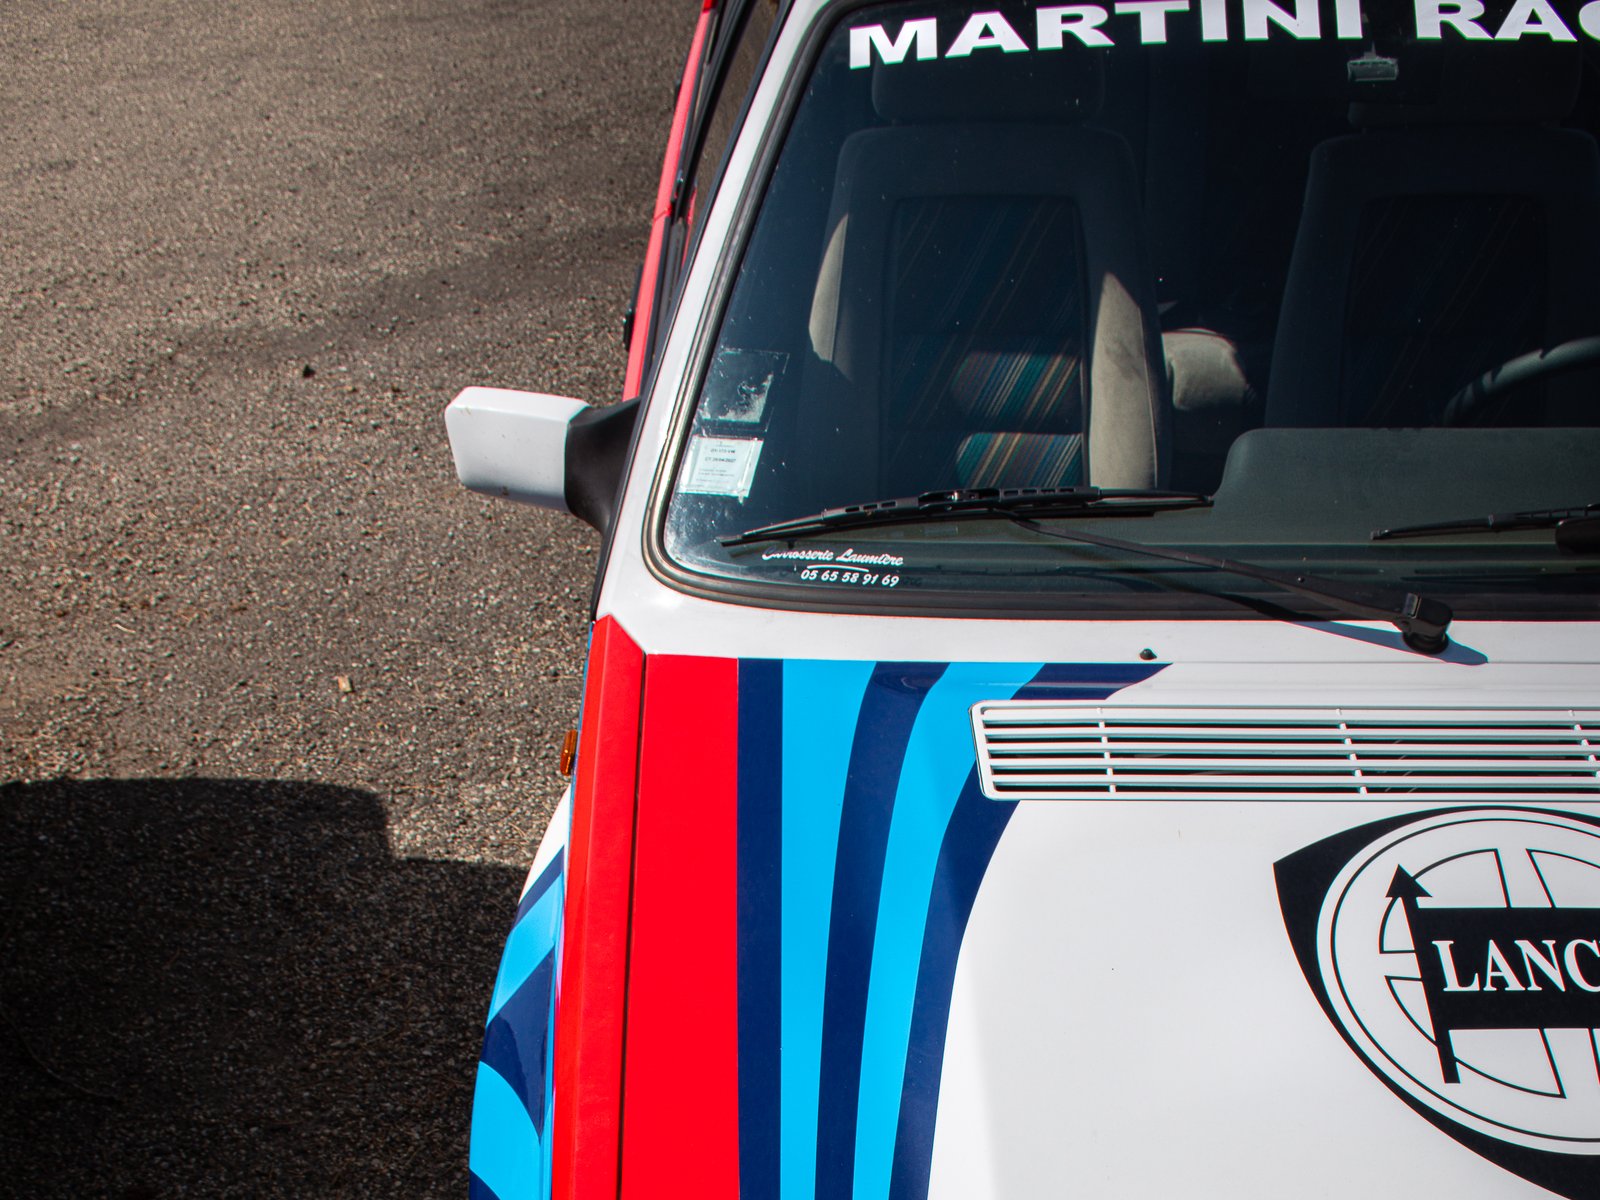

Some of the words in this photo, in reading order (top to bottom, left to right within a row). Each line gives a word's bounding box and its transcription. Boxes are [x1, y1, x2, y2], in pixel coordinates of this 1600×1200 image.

[848, 0, 1363, 68] MARTINI
[800, 569, 819, 580] 05
[821, 571, 838, 582] 65
[841, 572, 859, 584] 58
[862, 574, 879, 586] 91
[881, 574, 900, 587] 69
